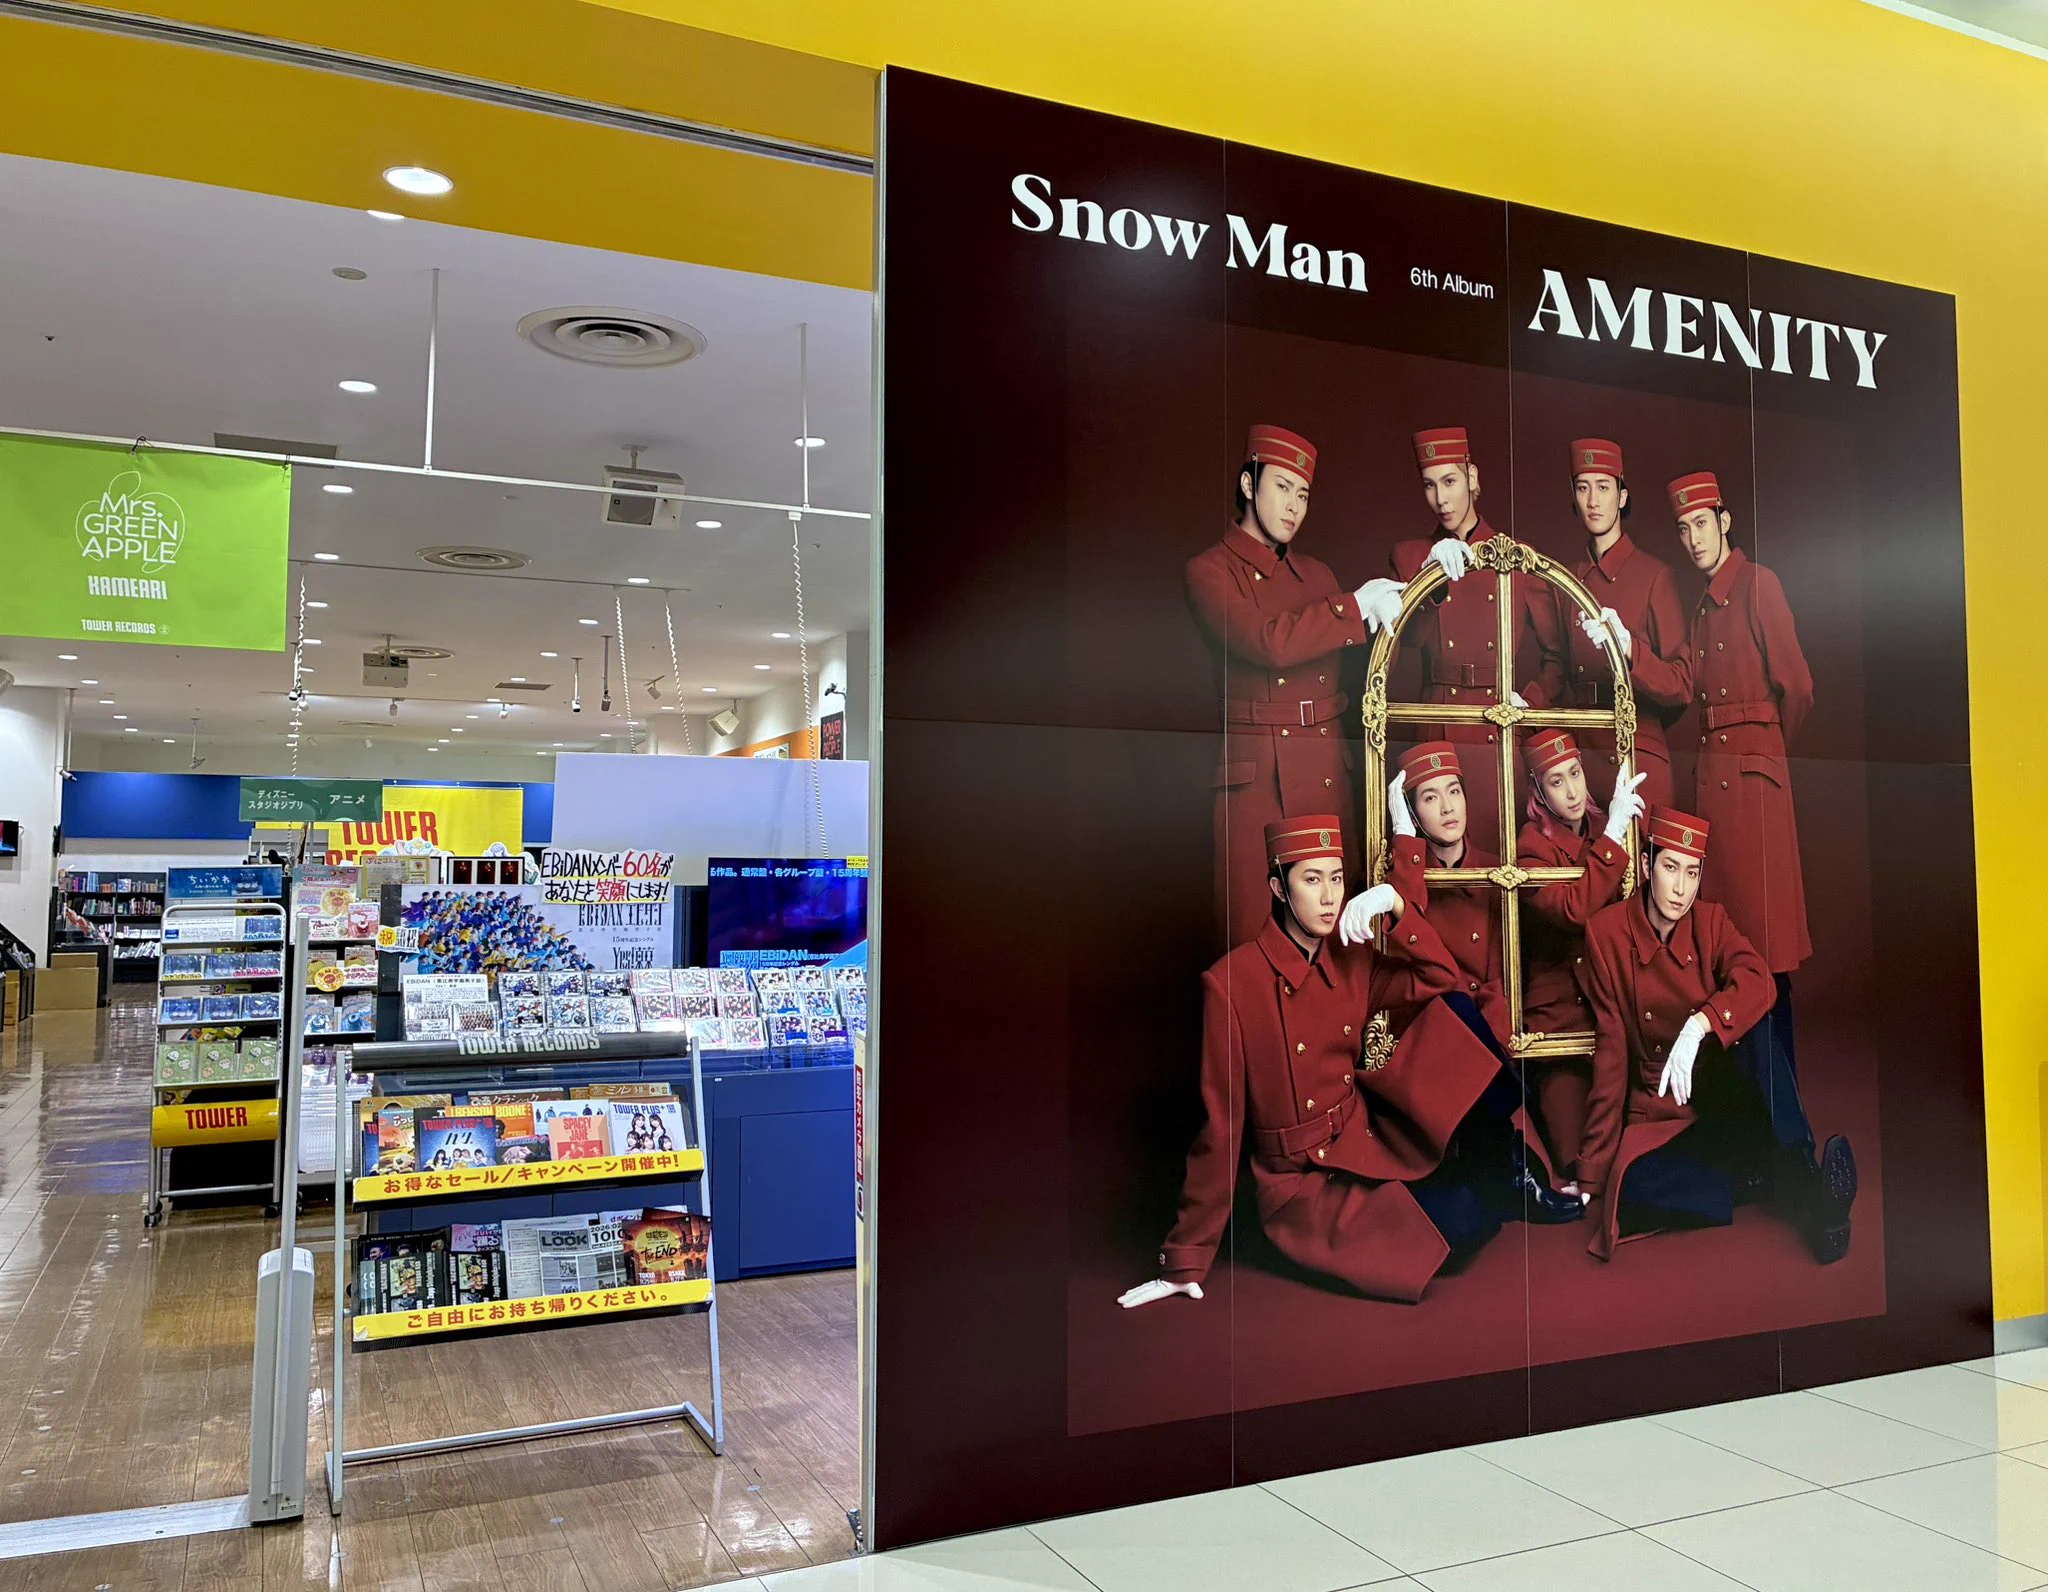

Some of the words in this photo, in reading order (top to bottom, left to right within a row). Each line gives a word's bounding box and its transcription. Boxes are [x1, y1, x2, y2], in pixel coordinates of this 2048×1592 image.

[1011, 173, 1210, 260] Snow
[1225, 213, 1368, 292] Man
[1410, 267, 1438, 290] 6th
[1442, 273, 1494, 299] Album
[1528, 268, 1888, 390] AMENITY
[100, 492, 163, 518] Mrs.
[83, 514, 178, 541] GREEN
[82, 536, 177, 564] APPLE
[88, 575, 168, 600] KAMEARI
[82, 619, 112, 632] TOWER
[115, 621, 156, 634] RECORDS
[257, 789, 295, 799] ディズニー
[329, 793, 366, 805] アニメ
[248, 800, 303, 810] スタジオジブリ
[760, 949, 808, 960] EBiDAN
[457, 1036, 518, 1055] TOWER
[523, 1032, 600, 1053] RECORDS
[613, 1104, 640, 1114] TOWER
[185, 1107, 248, 1131] TOWER
[563, 1117, 591, 1129] SPACEY
[570, 1128, 588, 1141] JANE
[541, 1234, 588, 1247] LOOK
[655, 1243, 678, 1259] END
